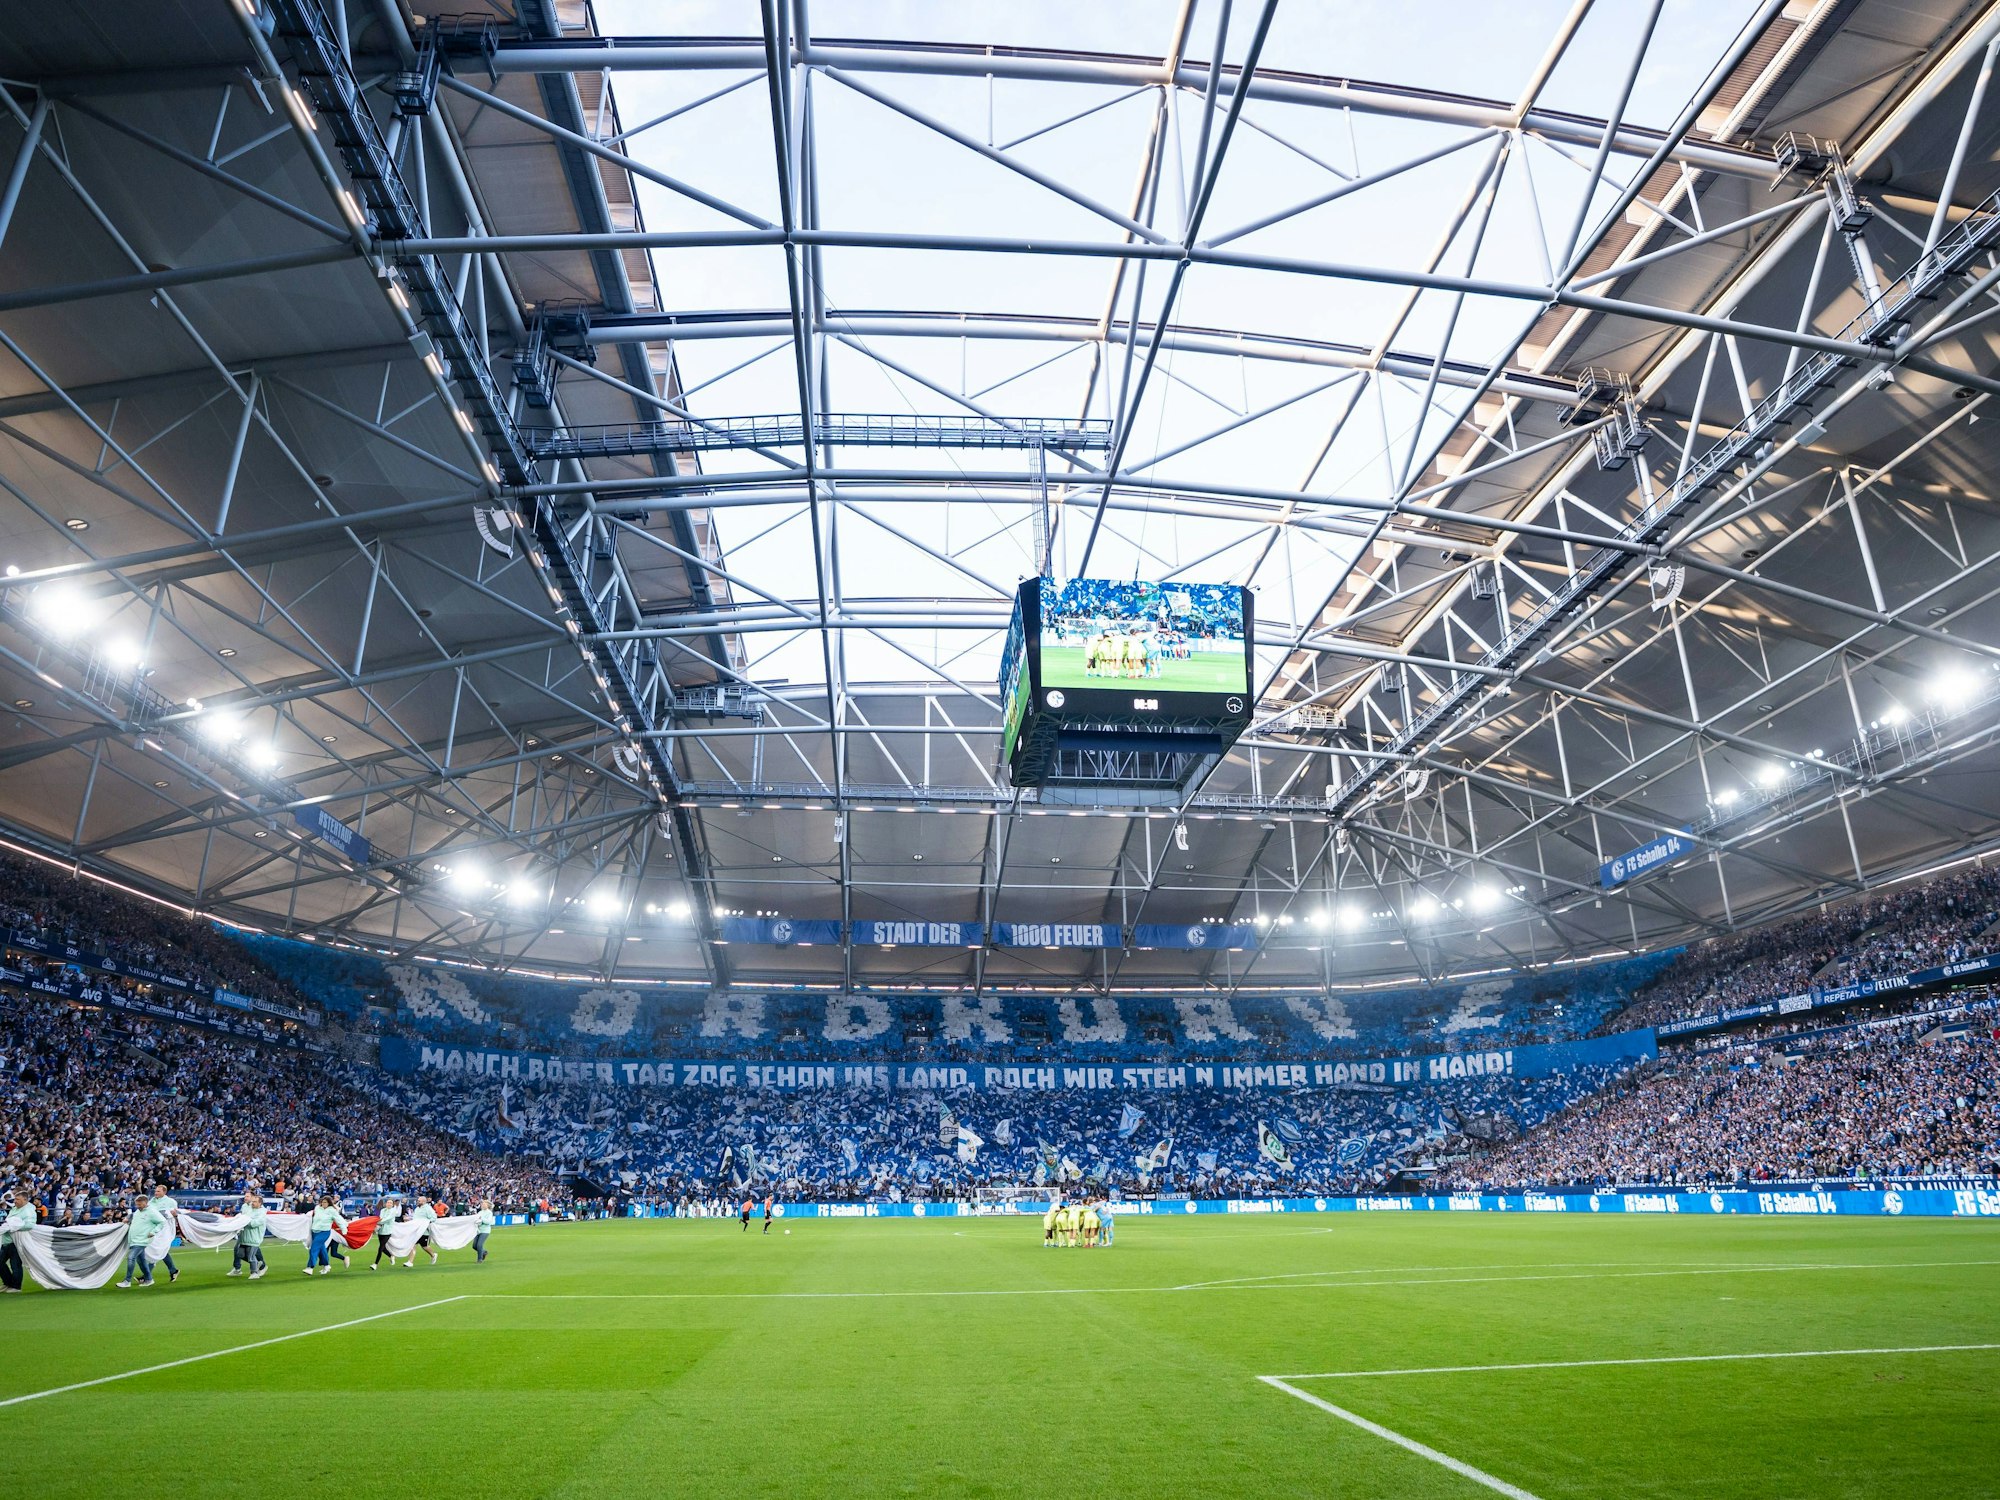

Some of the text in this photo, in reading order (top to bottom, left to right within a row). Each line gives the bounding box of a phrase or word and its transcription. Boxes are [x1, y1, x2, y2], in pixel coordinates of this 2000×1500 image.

[1626, 837, 1680, 873] FC Schalke 04
[873, 921, 961, 944] STADT DER
[1011, 924, 1104, 946] 1000 FEUER
[1960, 961, 1980, 972] Schalke
[1980, 959, 1990, 968] 04
[80, 987, 103, 1003] AVG
[1823, 989, 1861, 1004] REPETAL
[1658, 1025, 1671, 1035] DIE
[419, 1046, 520, 1079] MANCH
[528, 1055, 614, 1085] BÖSER
[622, 1063, 675, 1086] TAG
[683, 1065, 737, 1088] ZOG
[745, 1066, 836, 1090] SCHON
[844, 1066, 889, 1090] INS
[897, 1066, 976, 1091] LAND,
[984, 1067, 1051, 1089] DOCH
[1063, 1067, 1115, 1089] WIR
[1222, 1065, 1307, 1088] IMMER
[1314, 1062, 1386, 1085] HAND
[1393, 1060, 1421, 1083] IN
[1429, 1051, 1513, 1080] HAND!
[817, 1203, 880, 1217] FC Schalke 04
[1140, 1201, 1153, 1214] 04
[1227, 1200, 1285, 1213] FC Schalke 04
[1401, 1197, 1413, 1210] 04
[1623, 1194, 1679, 1212] FC Schalke 04
[1758, 1192, 1837, 1213] FC Schalke 04
[1954, 1192, 1976, 1217] FC
